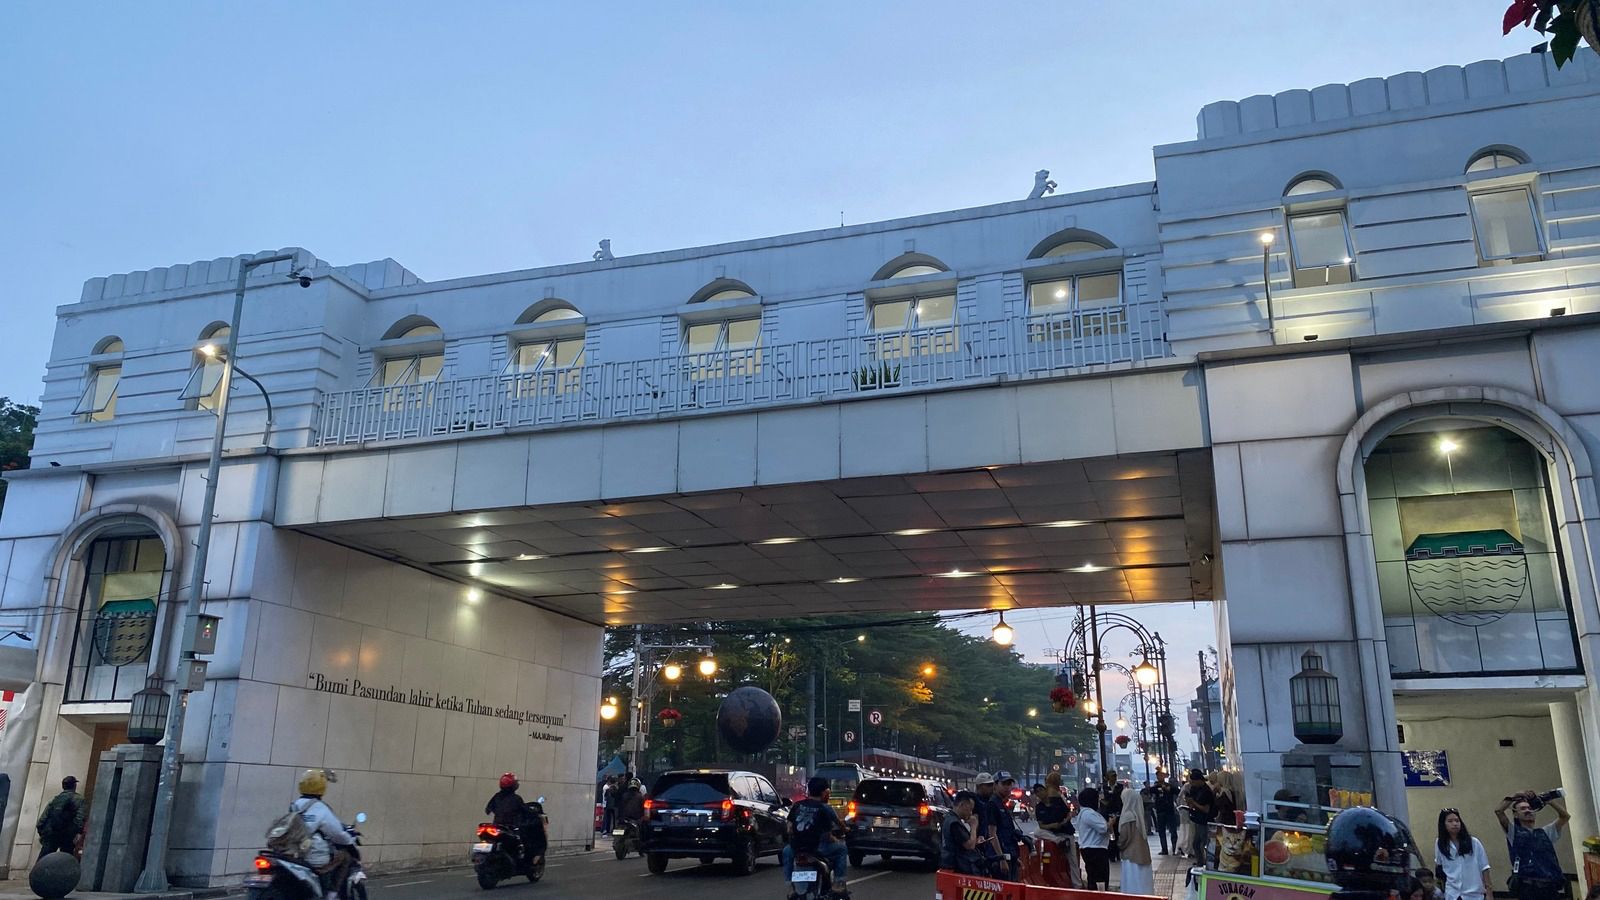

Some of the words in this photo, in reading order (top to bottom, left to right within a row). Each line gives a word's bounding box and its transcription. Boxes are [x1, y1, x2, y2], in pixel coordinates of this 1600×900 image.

[352, 679, 406, 703] Pasundan
[408, 688, 434, 708] lahir
[435, 692, 464, 712] ketika
[466, 698, 493, 717] Tuhan
[495, 704, 525, 726] sedang
[1218, 882, 1256, 899] JURAGAN
